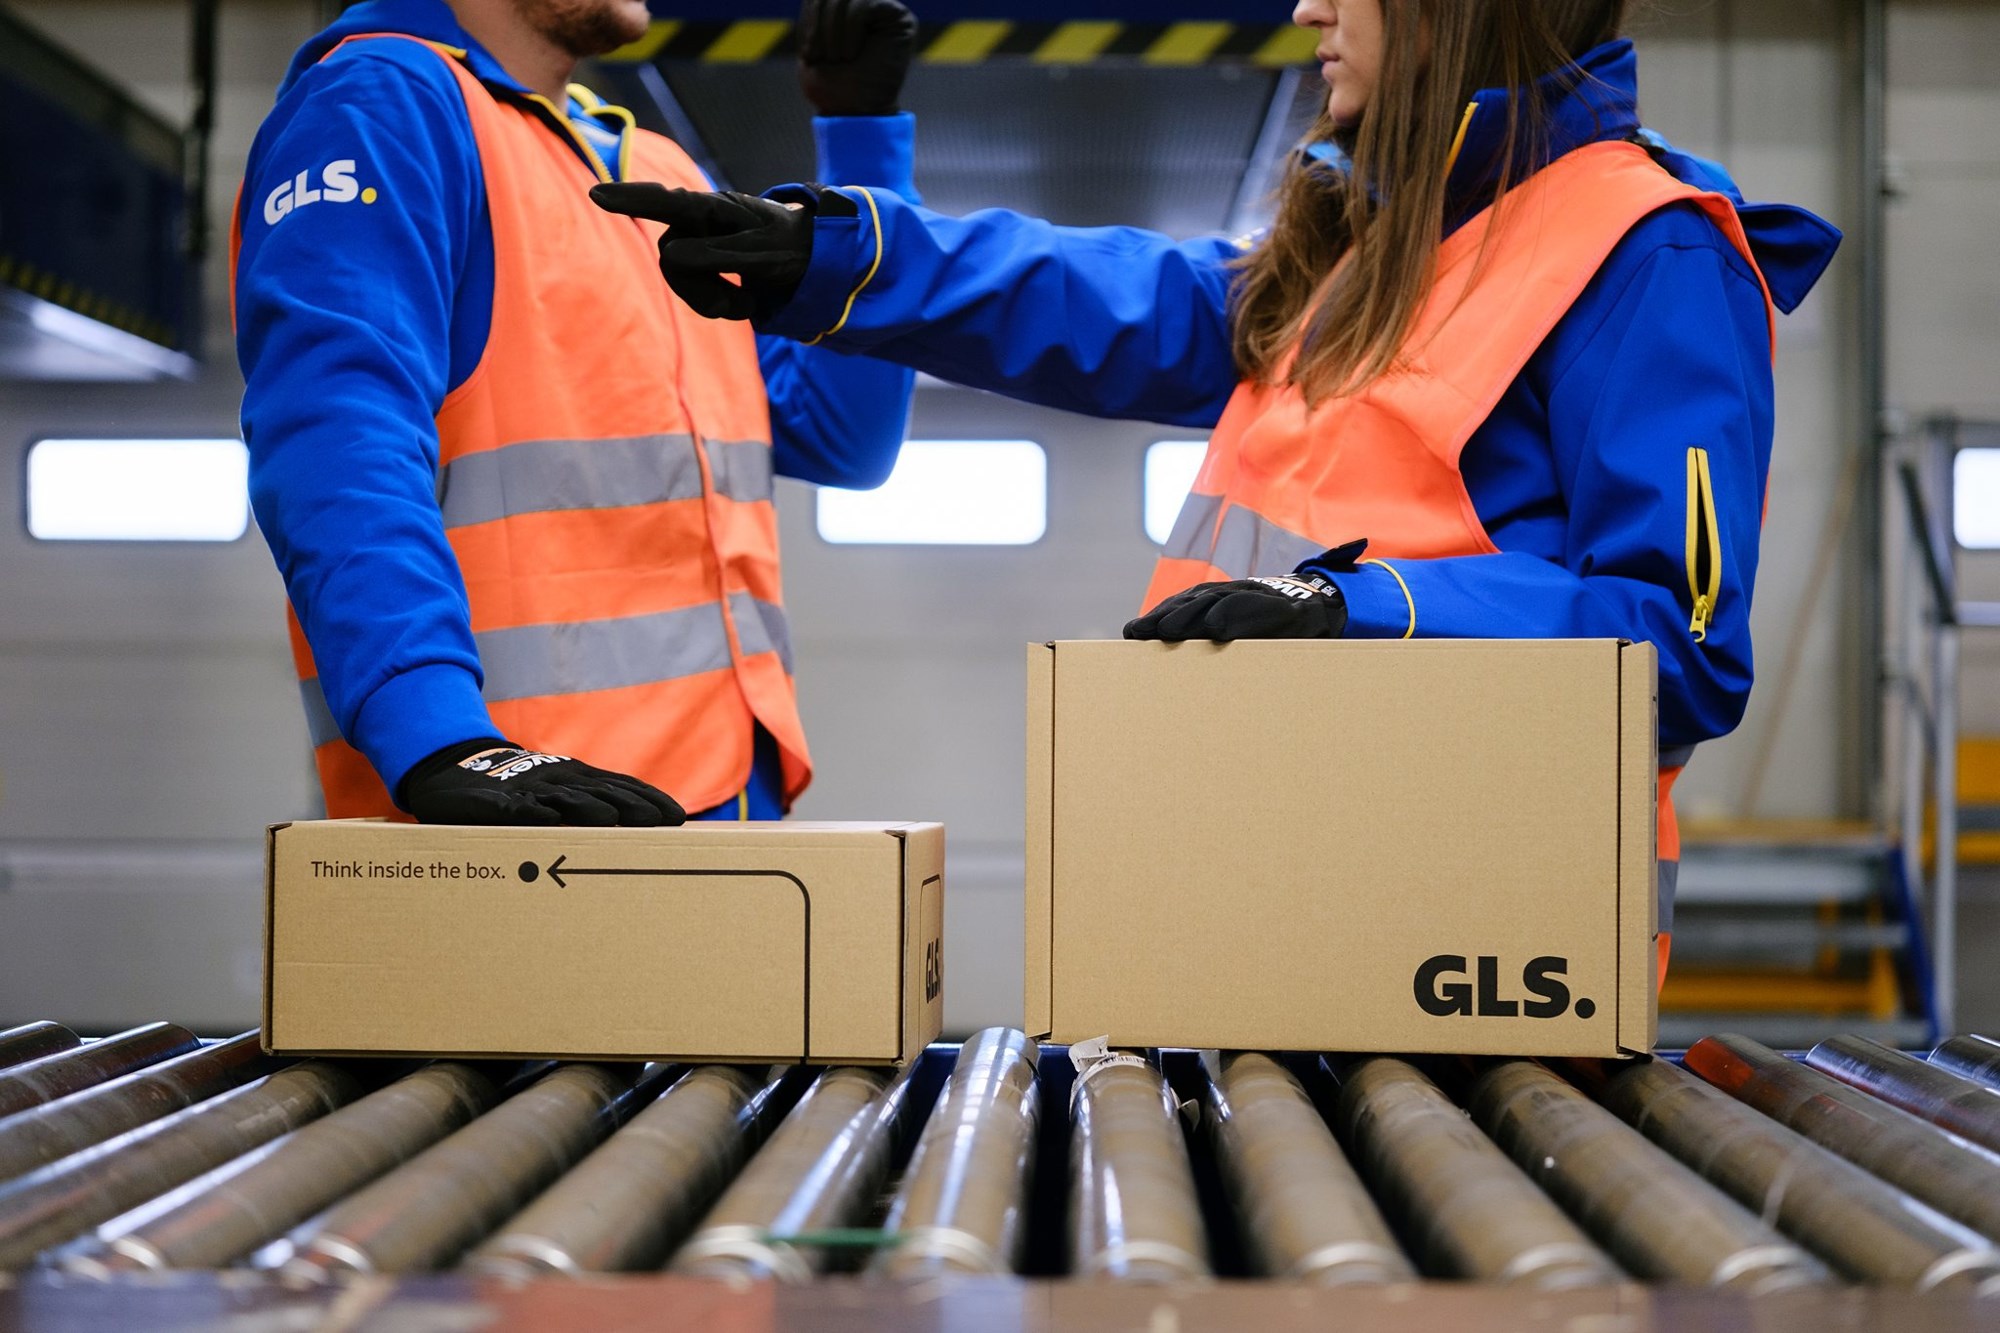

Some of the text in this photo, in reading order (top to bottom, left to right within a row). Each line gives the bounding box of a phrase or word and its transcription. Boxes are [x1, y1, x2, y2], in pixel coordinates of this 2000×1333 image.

[263, 159, 377, 226] GLS.
[311, 861, 506, 879] Think inside the box.
[1413, 954, 1596, 1019] GLS.
